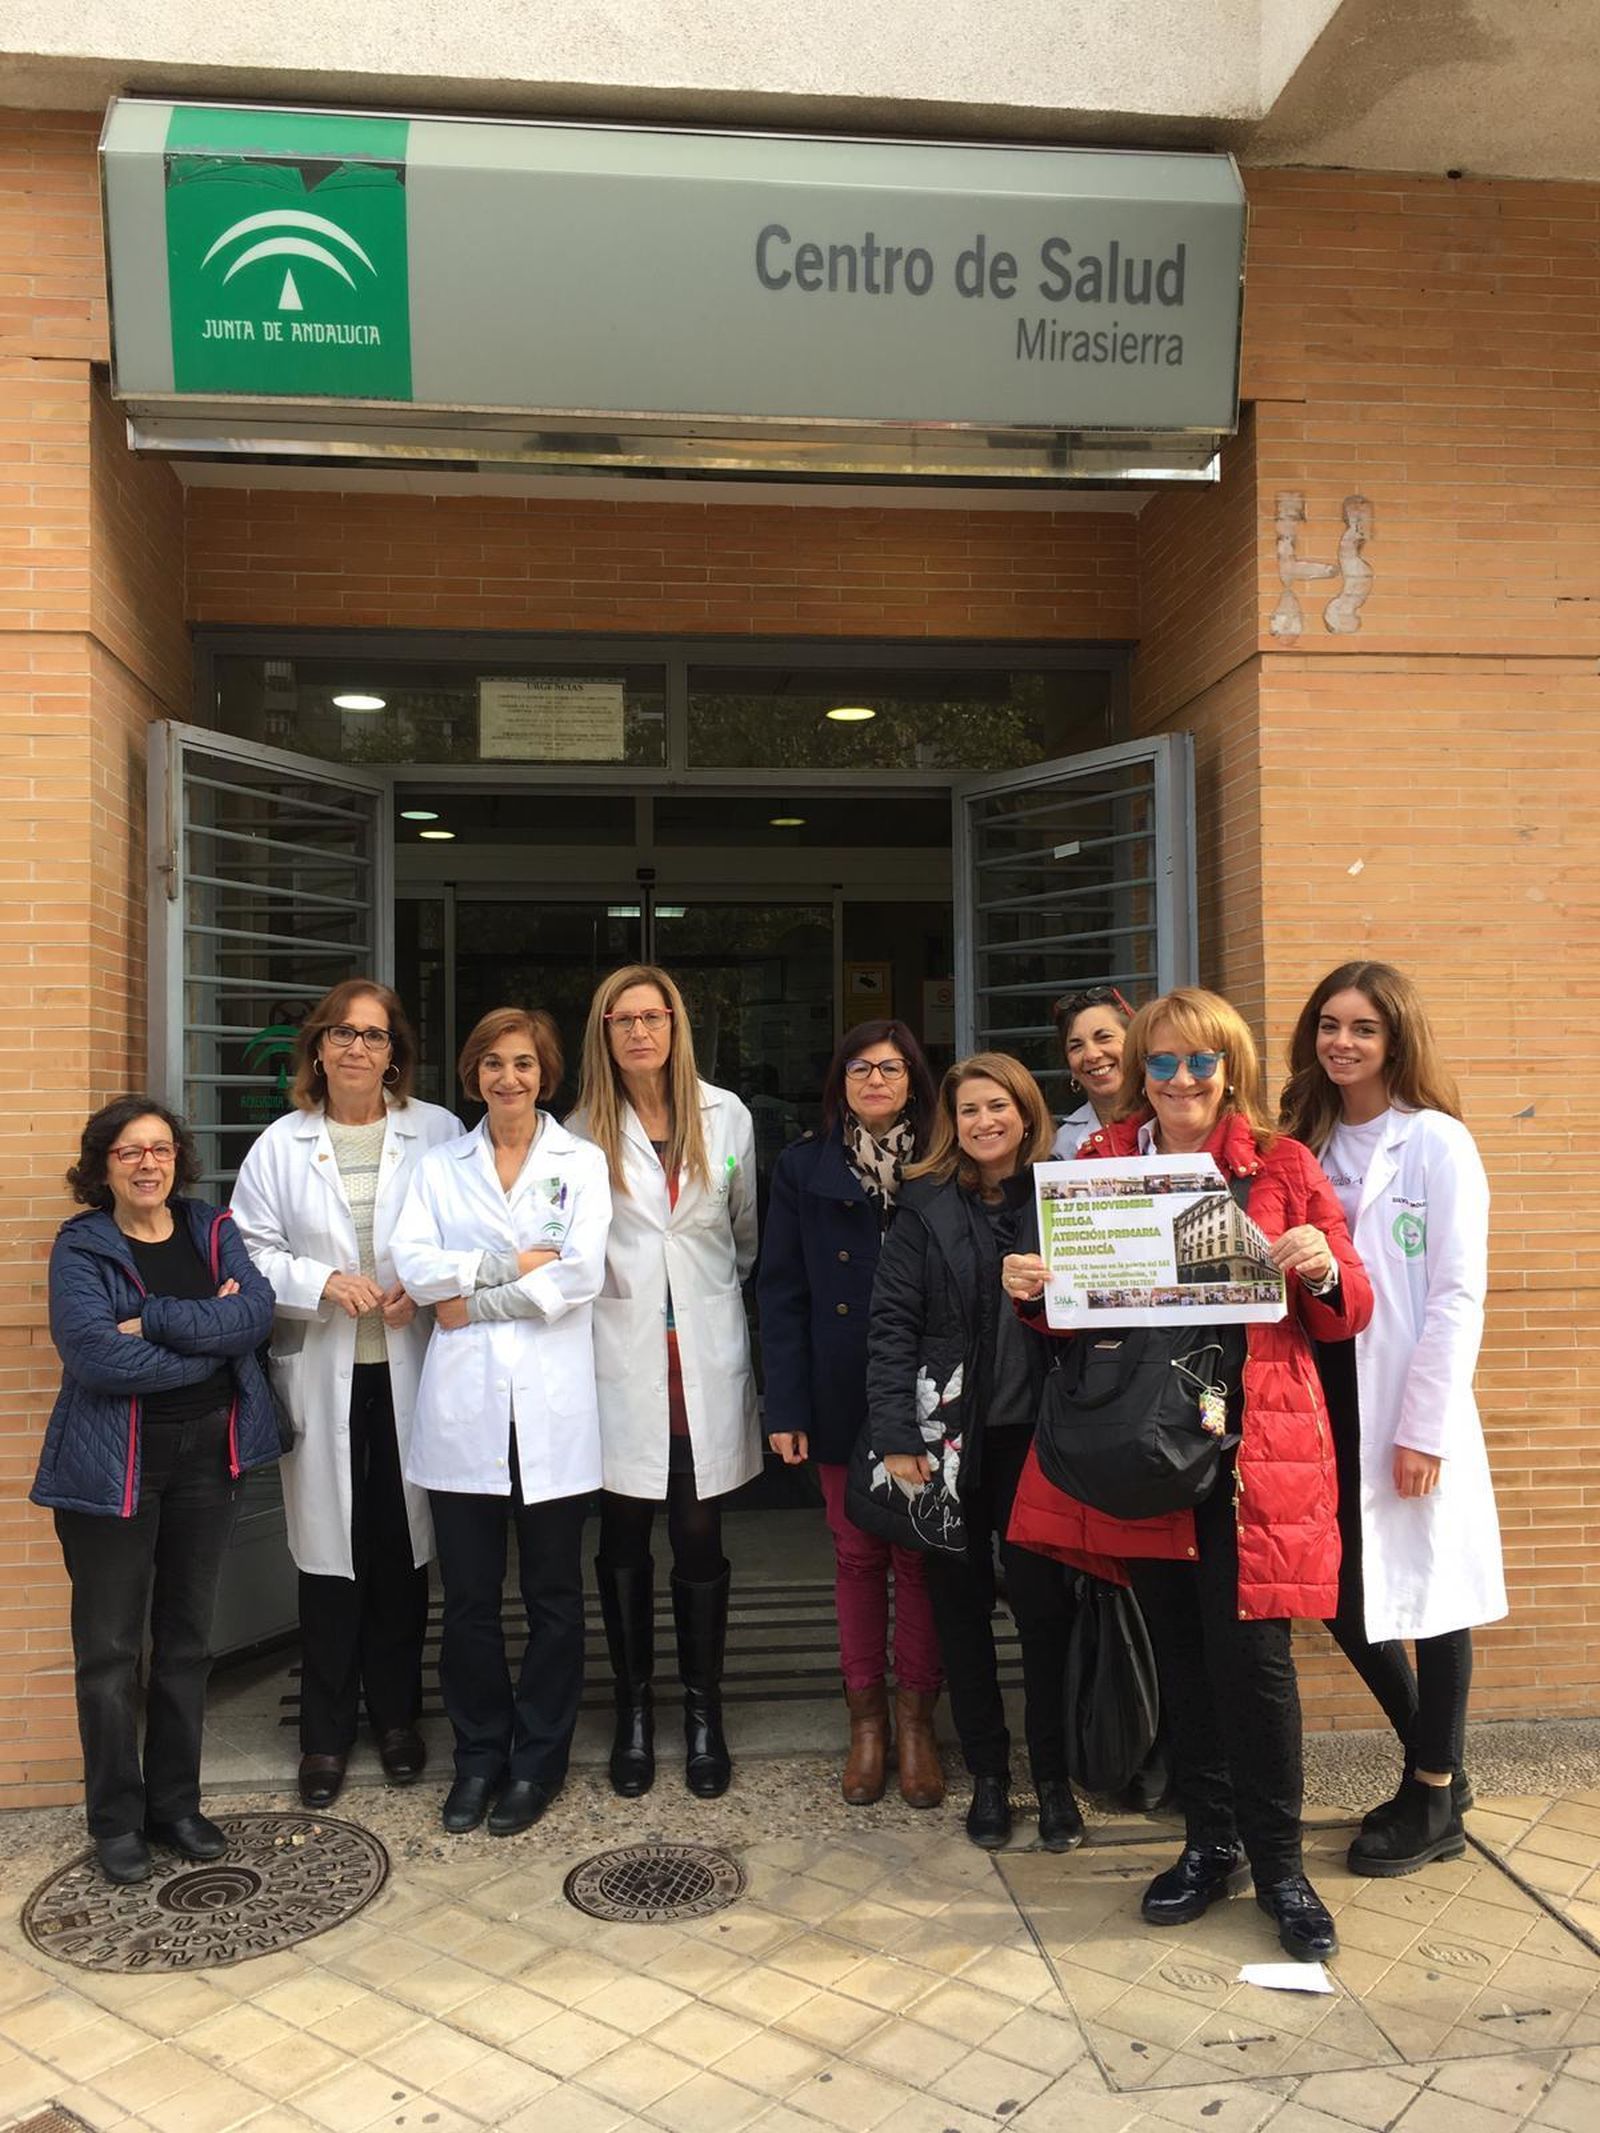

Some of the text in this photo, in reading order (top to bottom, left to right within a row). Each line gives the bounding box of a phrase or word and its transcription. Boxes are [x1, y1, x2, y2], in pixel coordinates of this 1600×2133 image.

[755, 223, 1187, 307] Centro de Salud
[201, 319, 381, 346] JUNTA DE ANDALUCIA
[1016, 317, 1185, 367] Mirasierra
[526, 682, 585, 692] URGENCIAS
[1051, 1198, 1154, 1213] EL 27 DE NOVIEMBRE
[1051, 1216, 1094, 1227] HUELGA
[1053, 1227, 1161, 1242] ATENCIÓN PRIMARIA
[1054, 1242, 1115, 1257] ANDALUCÍA
[153, 1902, 306, 1949] EMASAGRA
